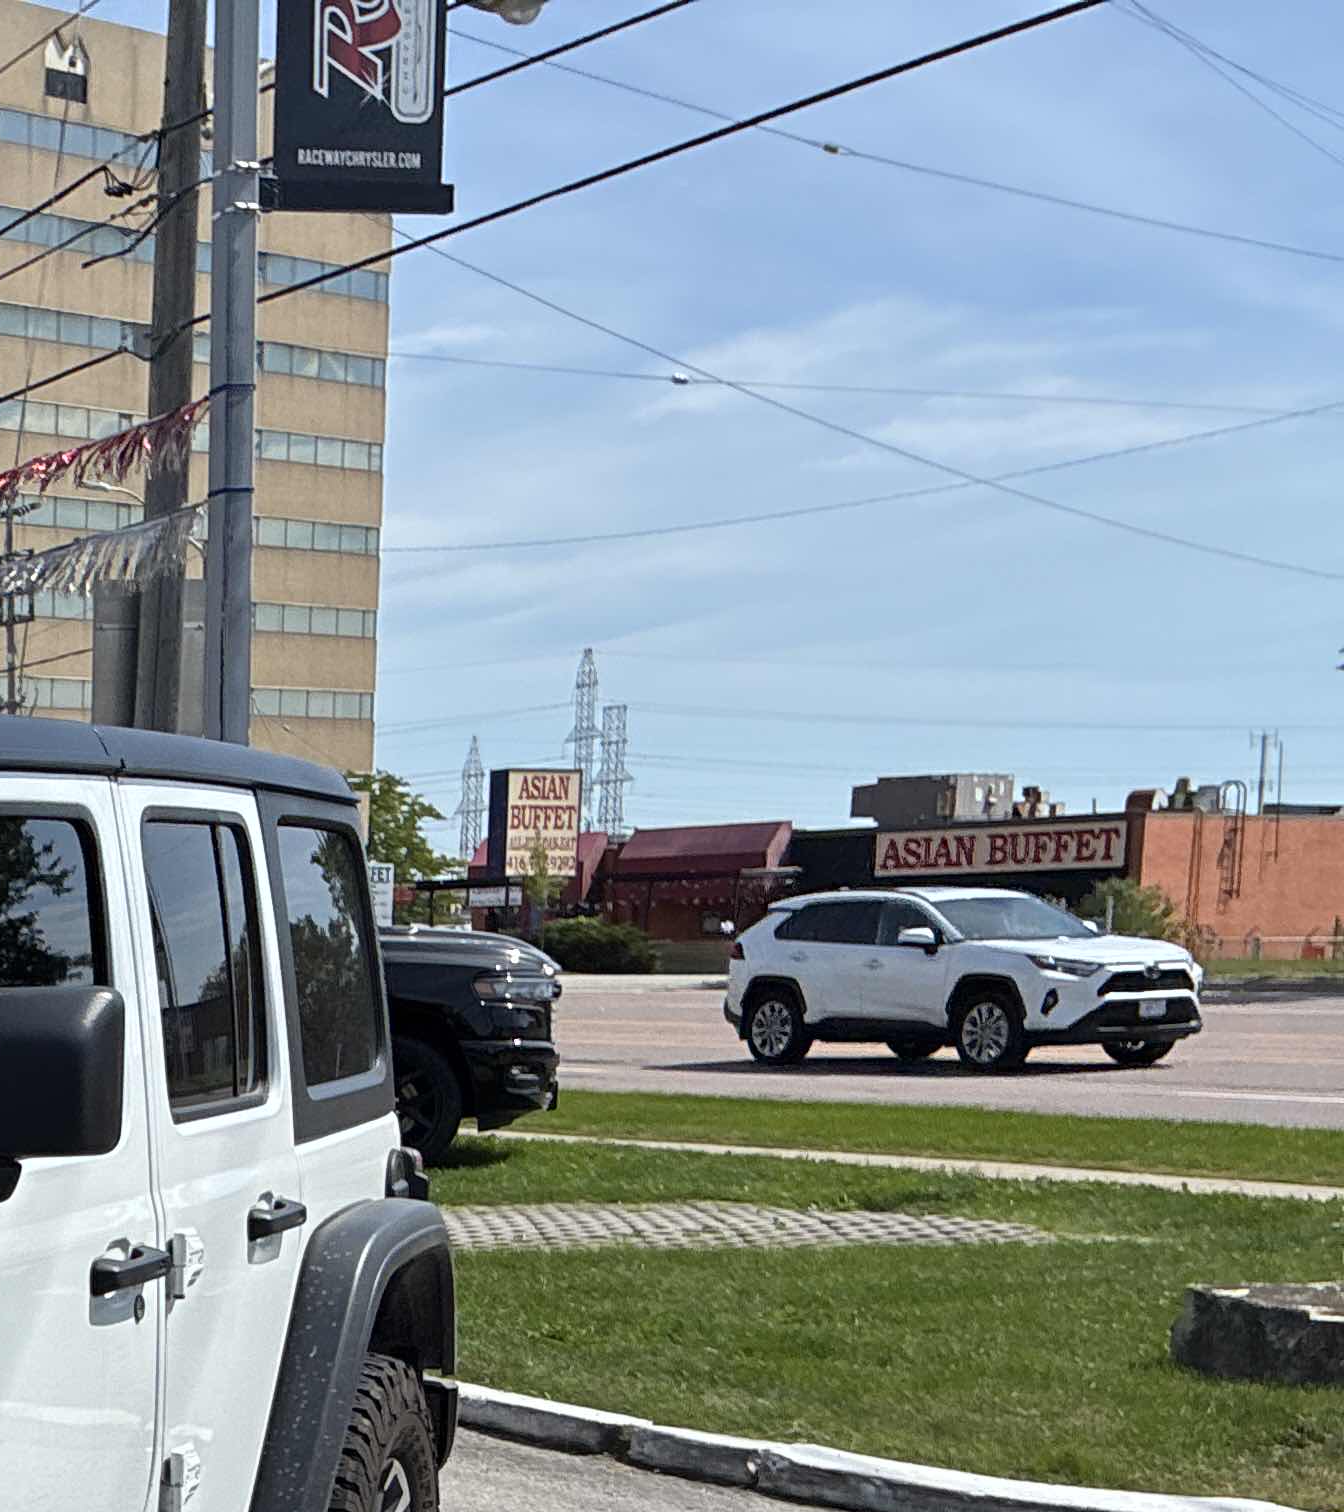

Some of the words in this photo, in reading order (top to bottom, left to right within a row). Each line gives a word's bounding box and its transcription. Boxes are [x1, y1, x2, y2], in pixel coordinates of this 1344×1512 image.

[297, 148, 421, 169] RACEWAYCHRYSLER.COM
[518, 775, 571, 800] ASIAN
[510, 804, 577, 830] BUFFET
[879, 834, 976, 870] ASIAN
[985, 827, 1121, 865] BUFFET
